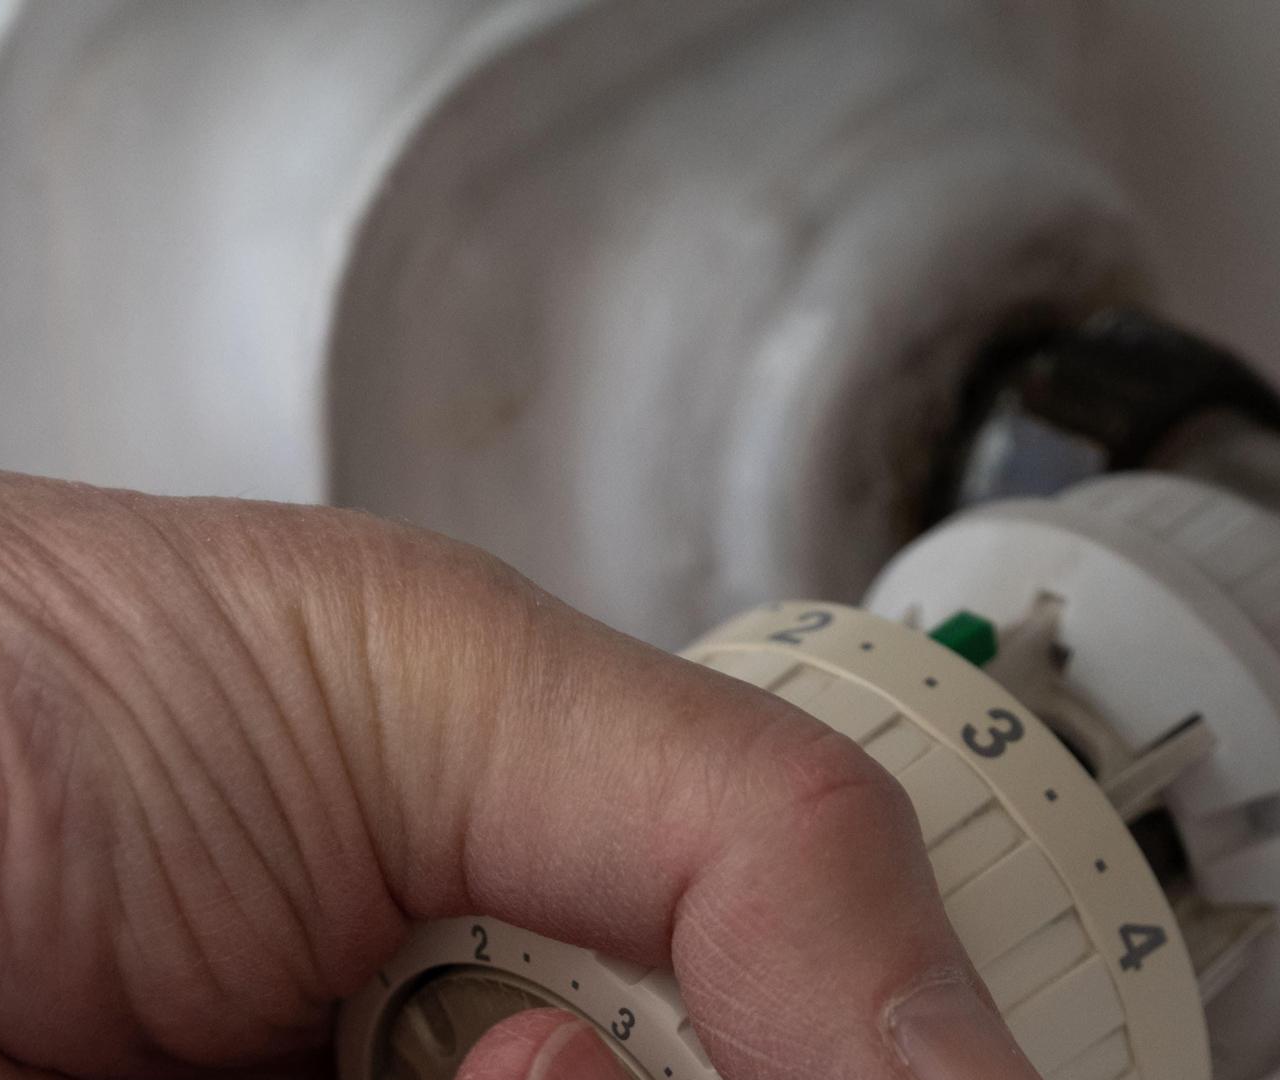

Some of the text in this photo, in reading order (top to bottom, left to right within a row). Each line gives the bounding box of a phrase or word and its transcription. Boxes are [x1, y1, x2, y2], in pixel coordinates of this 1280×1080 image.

[769, 611, 834, 645] 2
[961, 708, 1025, 760] 3
[470, 924, 491, 962] 2
[1119, 923, 1168, 972] 4
[611, 1007, 636, 1041] 3
